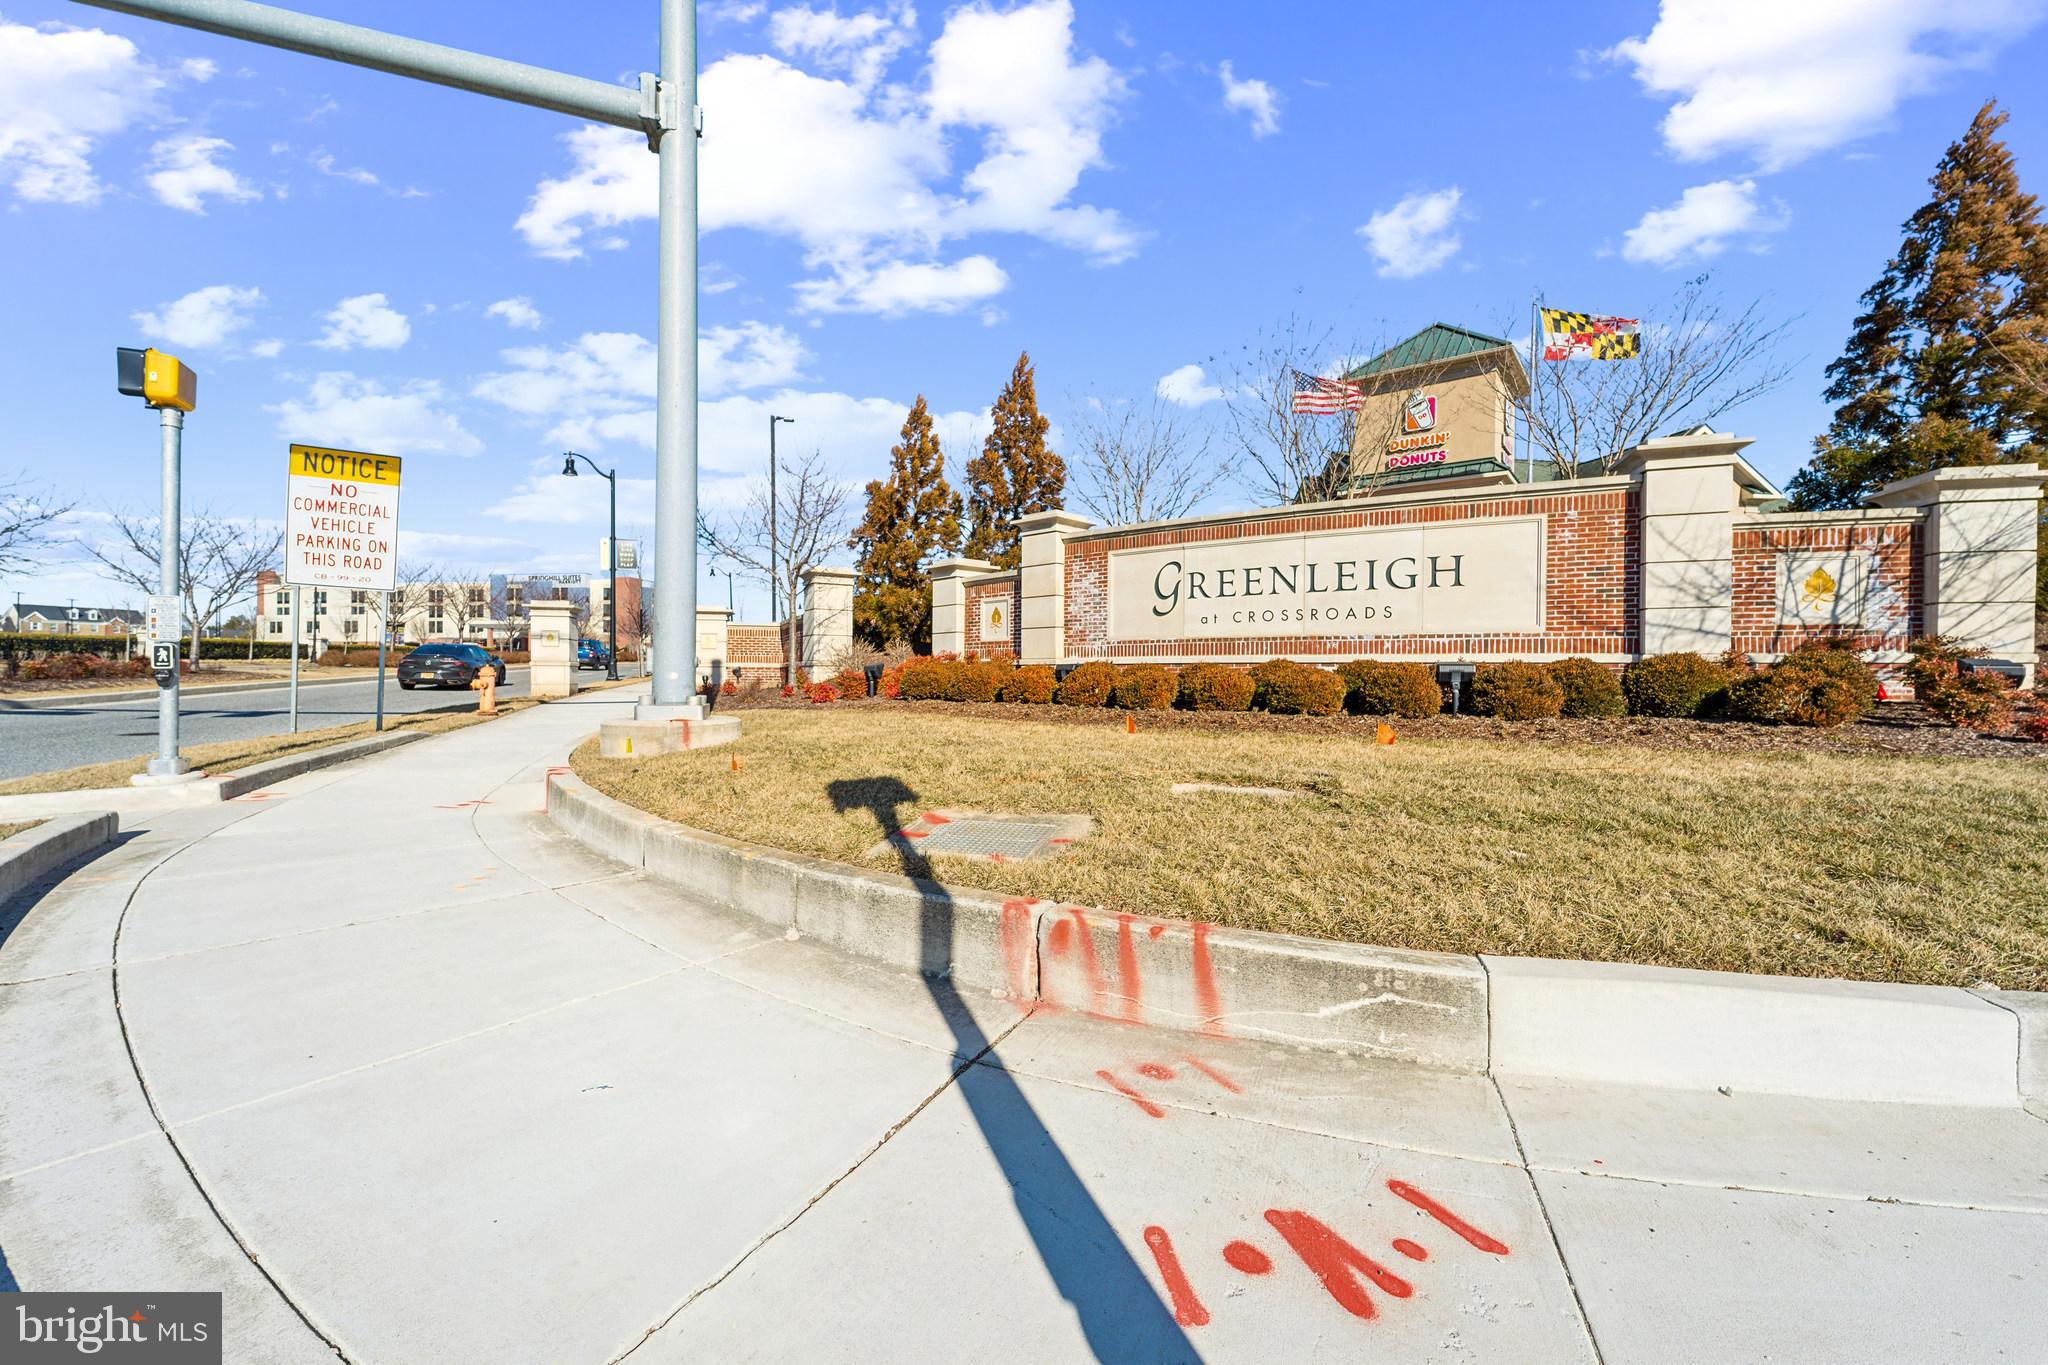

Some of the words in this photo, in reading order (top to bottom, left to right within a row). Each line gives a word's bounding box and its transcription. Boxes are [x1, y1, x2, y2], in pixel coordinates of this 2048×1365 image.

[1390, 432, 1450, 451] DUNKIN'
[303, 451, 388, 480] NOTICE
[1389, 450, 1447, 468] DONUTS
[331, 483, 358, 498] NO
[294, 497, 390, 519] COMMERCIAL
[311, 516, 376, 535] VEHICLE
[296, 533, 361, 551] PARKING
[368, 540, 388, 554] ON
[303, 551, 336, 567] THIS
[343, 555, 382, 570] ROAD
[1152, 554, 1465, 617] GREENLEIGH
[1200, 611, 1218, 625] at
[1232, 605, 1394, 624] CROSSROADS
